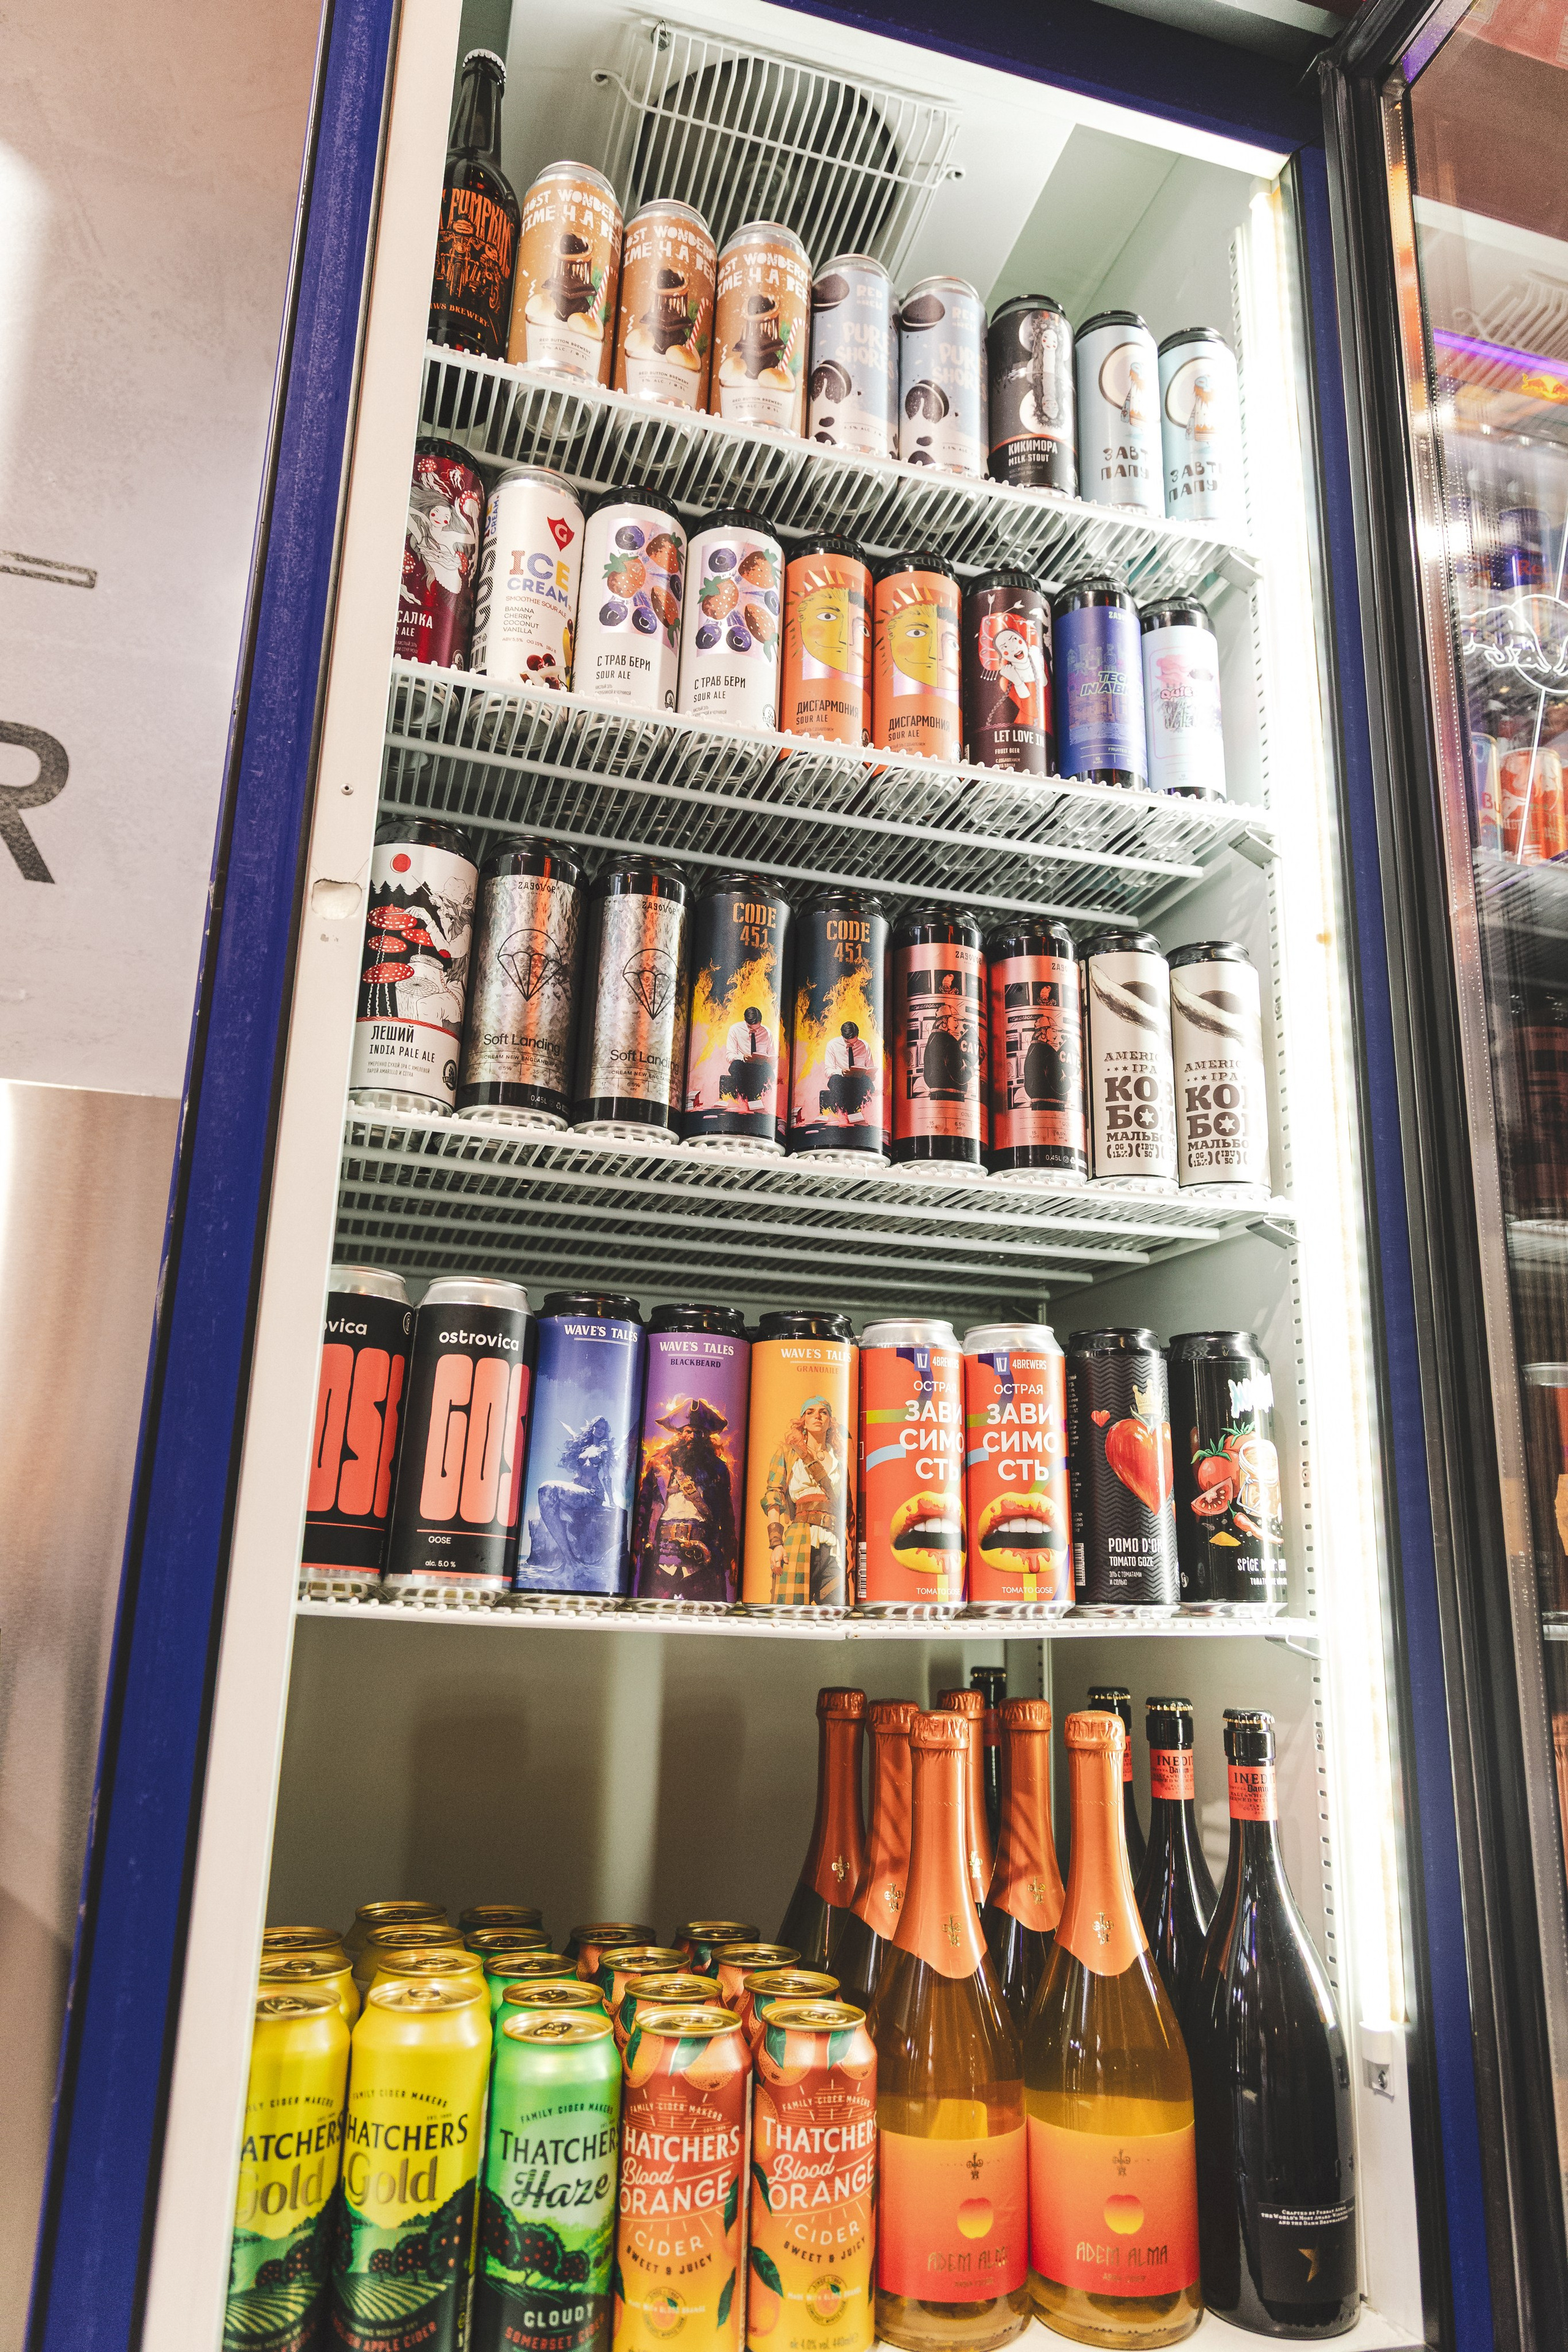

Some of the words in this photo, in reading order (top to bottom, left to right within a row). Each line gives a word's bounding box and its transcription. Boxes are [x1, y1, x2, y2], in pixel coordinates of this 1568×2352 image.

[521, 205, 556, 236] TIME
[579, 209, 595, 228] A
[676, 247, 690, 263] A
[765, 268, 780, 285] A
[571, 342, 591, 354] BREWERY
[1008, 440, 1058, 456] КИКИМОРА
[1008, 454, 1025, 466] MILK
[1027, 453, 1049, 462] STOUT
[1101, 464, 1150, 480] ПАПУ
[1169, 480, 1218, 502] ПАПУ
[509, 550, 570, 593] ICE
[507, 577, 568, 608] CREAM
[505, 596, 540, 605] SMOOTHIE
[541, 601, 558, 612] SOUR
[557, 609, 567, 619] ALE
[397, 610, 432, 629] САЛКА
[503, 620, 539, 629] COCONUT
[401, 627, 415, 637] ALE
[605, 655, 627, 666] ТРАВ
[629, 656, 651, 671] БЕРИ
[596, 670, 615, 680] SOUR
[617, 671, 631, 679] ALE
[701, 676, 721, 688] ТРАВ
[724, 676, 746, 688] БЕРИ
[693, 692, 710, 703] SOUR
[796, 699, 859, 719] ДИСГАРМОНИЯ
[796, 715, 813, 725] SOUR
[888, 715, 950, 733] ДИСГАРМОНИЯ
[888, 731, 905, 742] SOUR
[994, 729, 1010, 743] LET
[1012, 729, 1034, 744] LOVE
[1035, 733, 1045, 748] IN
[732, 902, 778, 929] CODE
[740, 924, 769, 949] 451
[826, 919, 871, 943] CODE
[834, 941, 864, 964] 451
[371, 1025, 414, 1043] ЛЕШИЙ
[369, 1044, 395, 1055] INDIA
[399, 1046, 420, 1059] PALE
[421, 1051, 435, 1063] ALE
[483, 1033, 508, 1046] Soft
[511, 1034, 560, 1057] Landing
[521, 1056, 549, 1065] ENGLAND
[610, 1049, 636, 1062] Soft
[639, 1051, 679, 1076] Landing
[1059, 1050, 1081, 1069] CAVE
[1131, 1063, 1158, 1074] IPA
[412, 1066, 430, 1074] ХМЕЛЕВОЙ
[1211, 1072, 1238, 1082] IPA
[530, 1095, 547, 1104] 0.45L
[439, 1328, 519, 1352] ostrovica
[564, 1324, 606, 1338] WAVE'S
[611, 1327, 638, 1343] TALES
[659, 1341, 698, 1352] WAVE'S
[704, 1342, 734, 1357] TALES
[781, 1348, 821, 1360] WAVE'S
[826, 1349, 852, 1363] TALES
[669, 1359, 722, 1369] BLACKBEARD
[797, 1365, 839, 1375] GRANUAILE
[932, 1355, 960, 1370] 4BREWERS
[1012, 1359, 1047, 1370] 4BREWERS
[913, 1379, 957, 1393] ОСТРАЯ
[993, 1383, 1044, 1395] ОСТРАЯ
[905, 1399, 962, 1426] ЗАВИ
[986, 1403, 1054, 1426] ЗАВИ
[899, 1428, 965, 1454] СИМО
[982, 1431, 1059, 1453] СИМО
[915, 1457, 960, 1482] СТЬ
[997, 1459, 1049, 1481] СТЬ
[428, 1536, 451, 1545] GOSE
[1108, 1537, 1139, 1553] POMO
[424, 1559, 437, 1567] alc.
[1109, 1556, 1136, 1567] TOMATO
[1137, 1556, 1154, 1567] GOZE
[916, 1587, 946, 1596] TOMATO
[1001, 1586, 1033, 1595] TOMATO
[1035, 1586, 1054, 1595] GOSE
[379, 2090, 405, 2099] CIDER
[411, 2091, 448, 2109] MAKERS
[782, 2098, 813, 2112] FAMILY
[817, 2095, 844, 2105] CIDER
[846, 2095, 871, 2108] MAKERS
[520, 2108, 552, 2125] FAMILY
[557, 2103, 585, 2116] CIDER
[630, 2103, 654, 2114] FAMILY
[658, 2103, 684, 2113] CIDER
[689, 2105, 723, 2122] MAKERS
[346, 2113, 468, 2152] HATCHERS
[623, 2125, 741, 2163] HATCHERS
[348, 2150, 438, 2207] Gold
[620, 2157, 675, 2186] Blood
[767, 2154, 835, 2185] Blood
[511, 2168, 611, 2209] Haze
[768, 2153, 875, 2211] ORANGE
[620, 2169, 732, 2216] ORANGE
[794, 2219, 861, 2246] CIDER
[635, 2231, 704, 2258] CIDER
[783, 2240, 823, 2264] SWEET
[841, 2236, 866, 2261] JUICY
[1076, 2241, 1120, 2266] ADEM
[1128, 2244, 1168, 2266] ALMA
[626, 2244, 658, 2274] SWEET
[679, 2254, 714, 2275] JUICY
[928, 2252, 971, 2272] ADEM
[524, 2301, 595, 2329] CLOUDY
[504, 2326, 573, 2351] SOMERSET
